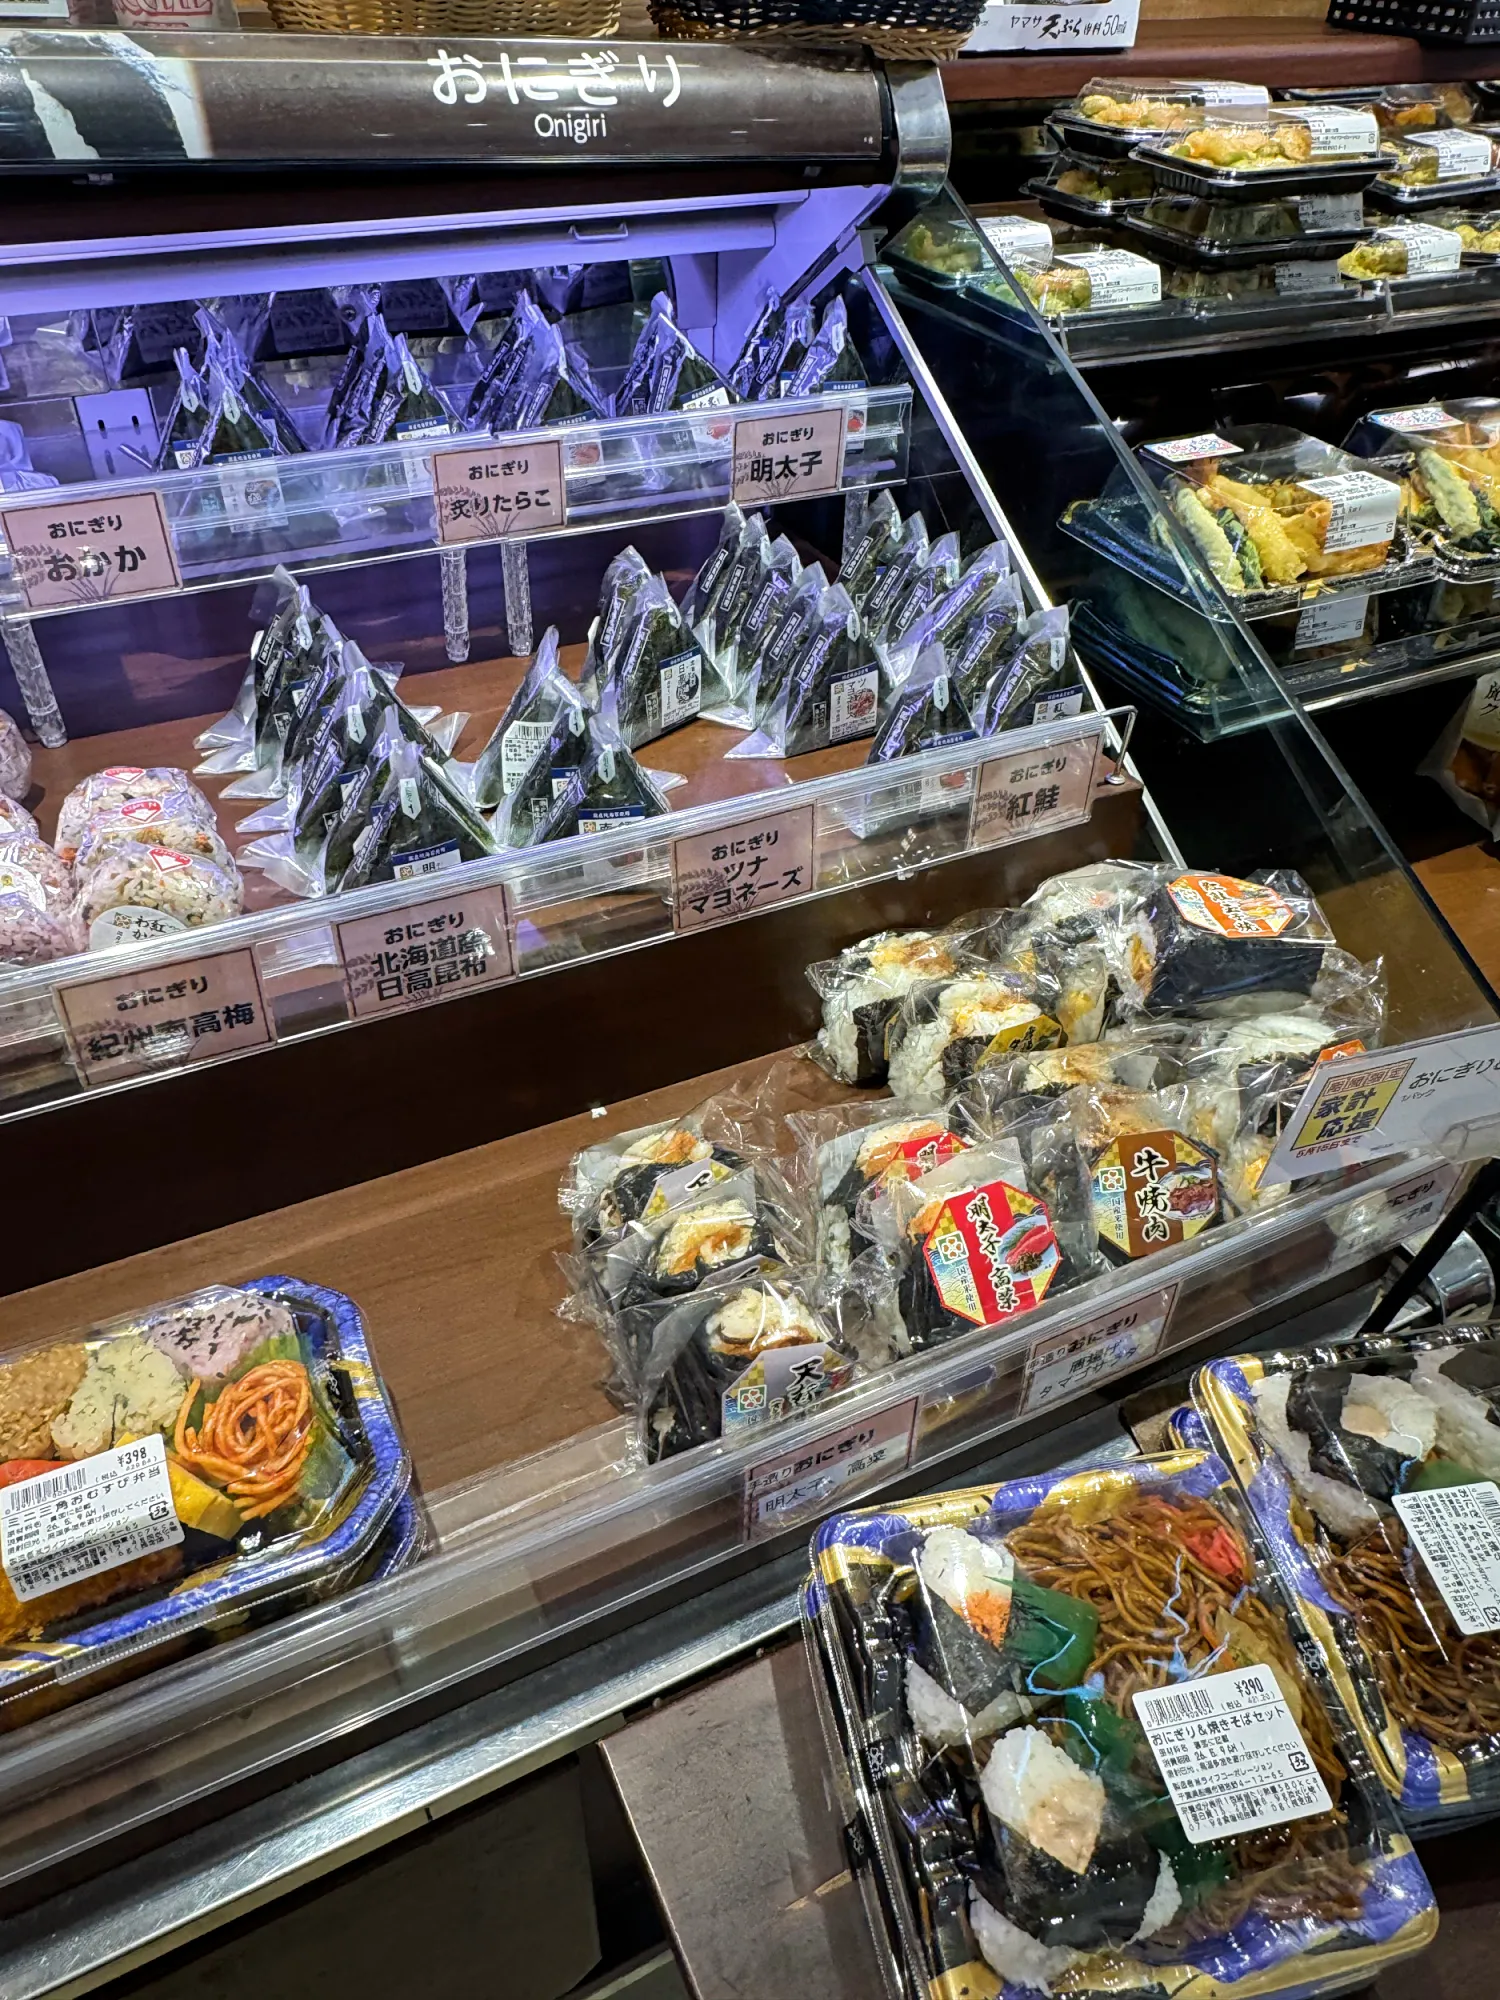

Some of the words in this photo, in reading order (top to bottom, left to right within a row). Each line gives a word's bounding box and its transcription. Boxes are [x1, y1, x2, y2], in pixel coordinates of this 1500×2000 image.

[427, 49, 681, 107] おにぎり
[534, 113, 607, 144] Onigiri
[762, 427, 814, 446] おにぎり
[468, 459, 529, 480] おにぎり
[750, 450, 823, 483] 明太子
[450, 488, 551, 521] 炙りたらこ
[47, 514, 123, 539] おにぎり
[44, 544, 147, 582] おかか
[1009, 757, 1067, 783] おにぎり
[1006, 784, 1060, 821] 紅鮭
[711, 830, 779, 861] おにぎり
[723, 855, 768, 883] ツナ
[688, 865, 804, 915] マヨネーズ
[384, 911, 465, 945] おにぎり
[370, 927, 492, 977] 北海道産
[114, 975, 208, 1012] おにぎり
[376, 959, 487, 1001] 日高昆布
[1313, 1087, 1378, 1120] 家計
[1315, 1107, 1380, 1141] 応援
[1132, 1148, 1168, 1241] 牛焼肉
[117, 1446, 148, 1468] ¥398
[8, 1466, 161, 1528] ミニ三角おむすび弁当
[1234, 1676, 1265, 1698] ¥390
[1150, 1705, 1286, 1747] おにぎり&焼きそばセット
